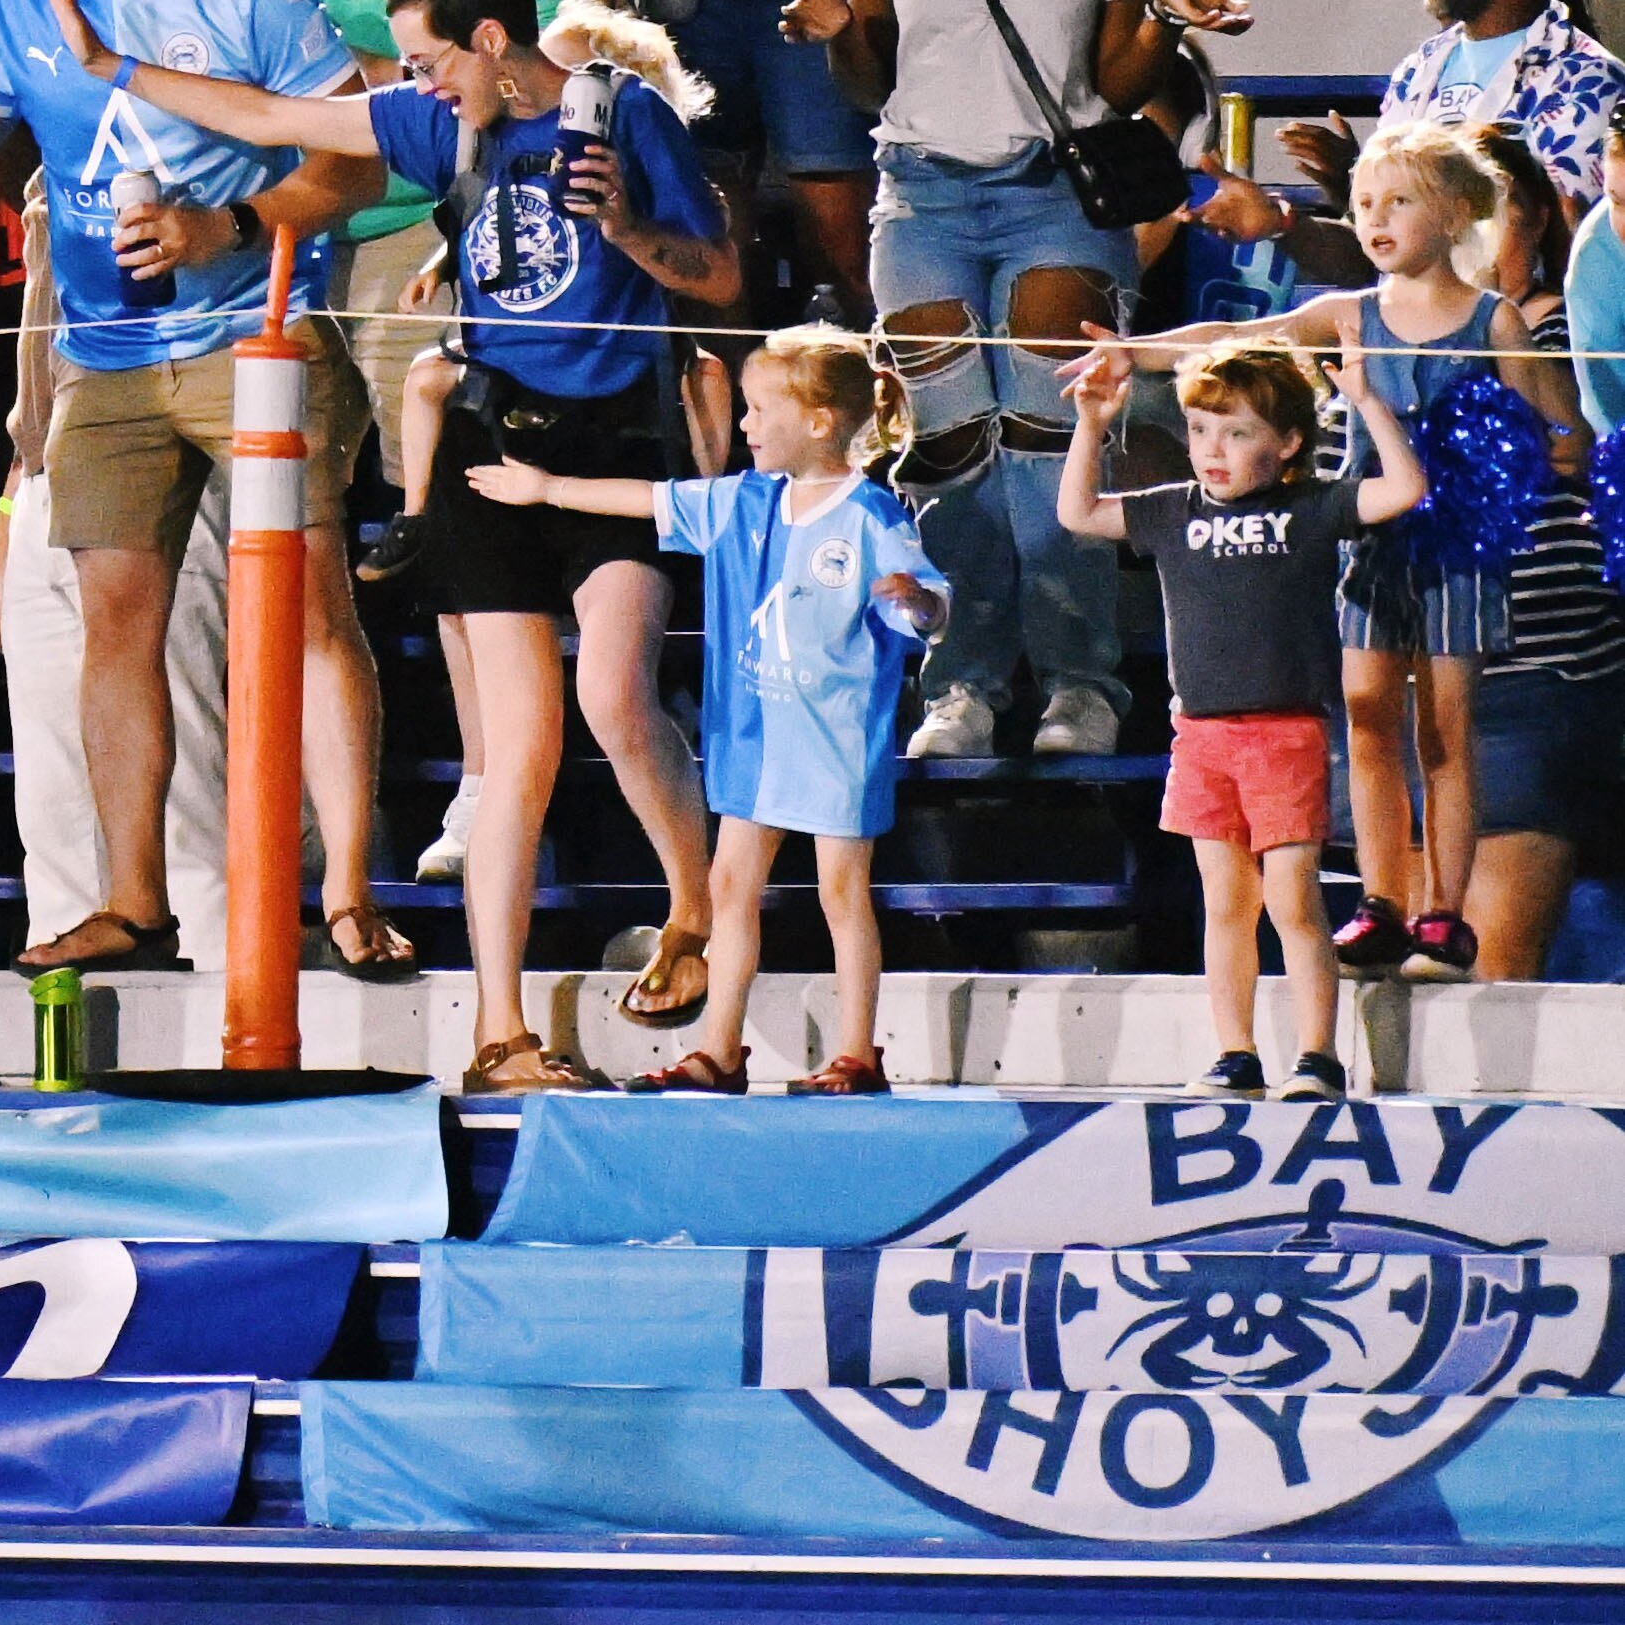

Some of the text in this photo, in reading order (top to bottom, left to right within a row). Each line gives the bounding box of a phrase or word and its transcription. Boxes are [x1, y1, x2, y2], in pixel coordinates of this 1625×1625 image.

[1439, 88, 1480, 110] BAY
[1212, 541, 1290, 559] SCHOOL
[1145, 1104, 1525, 1208] BAY
